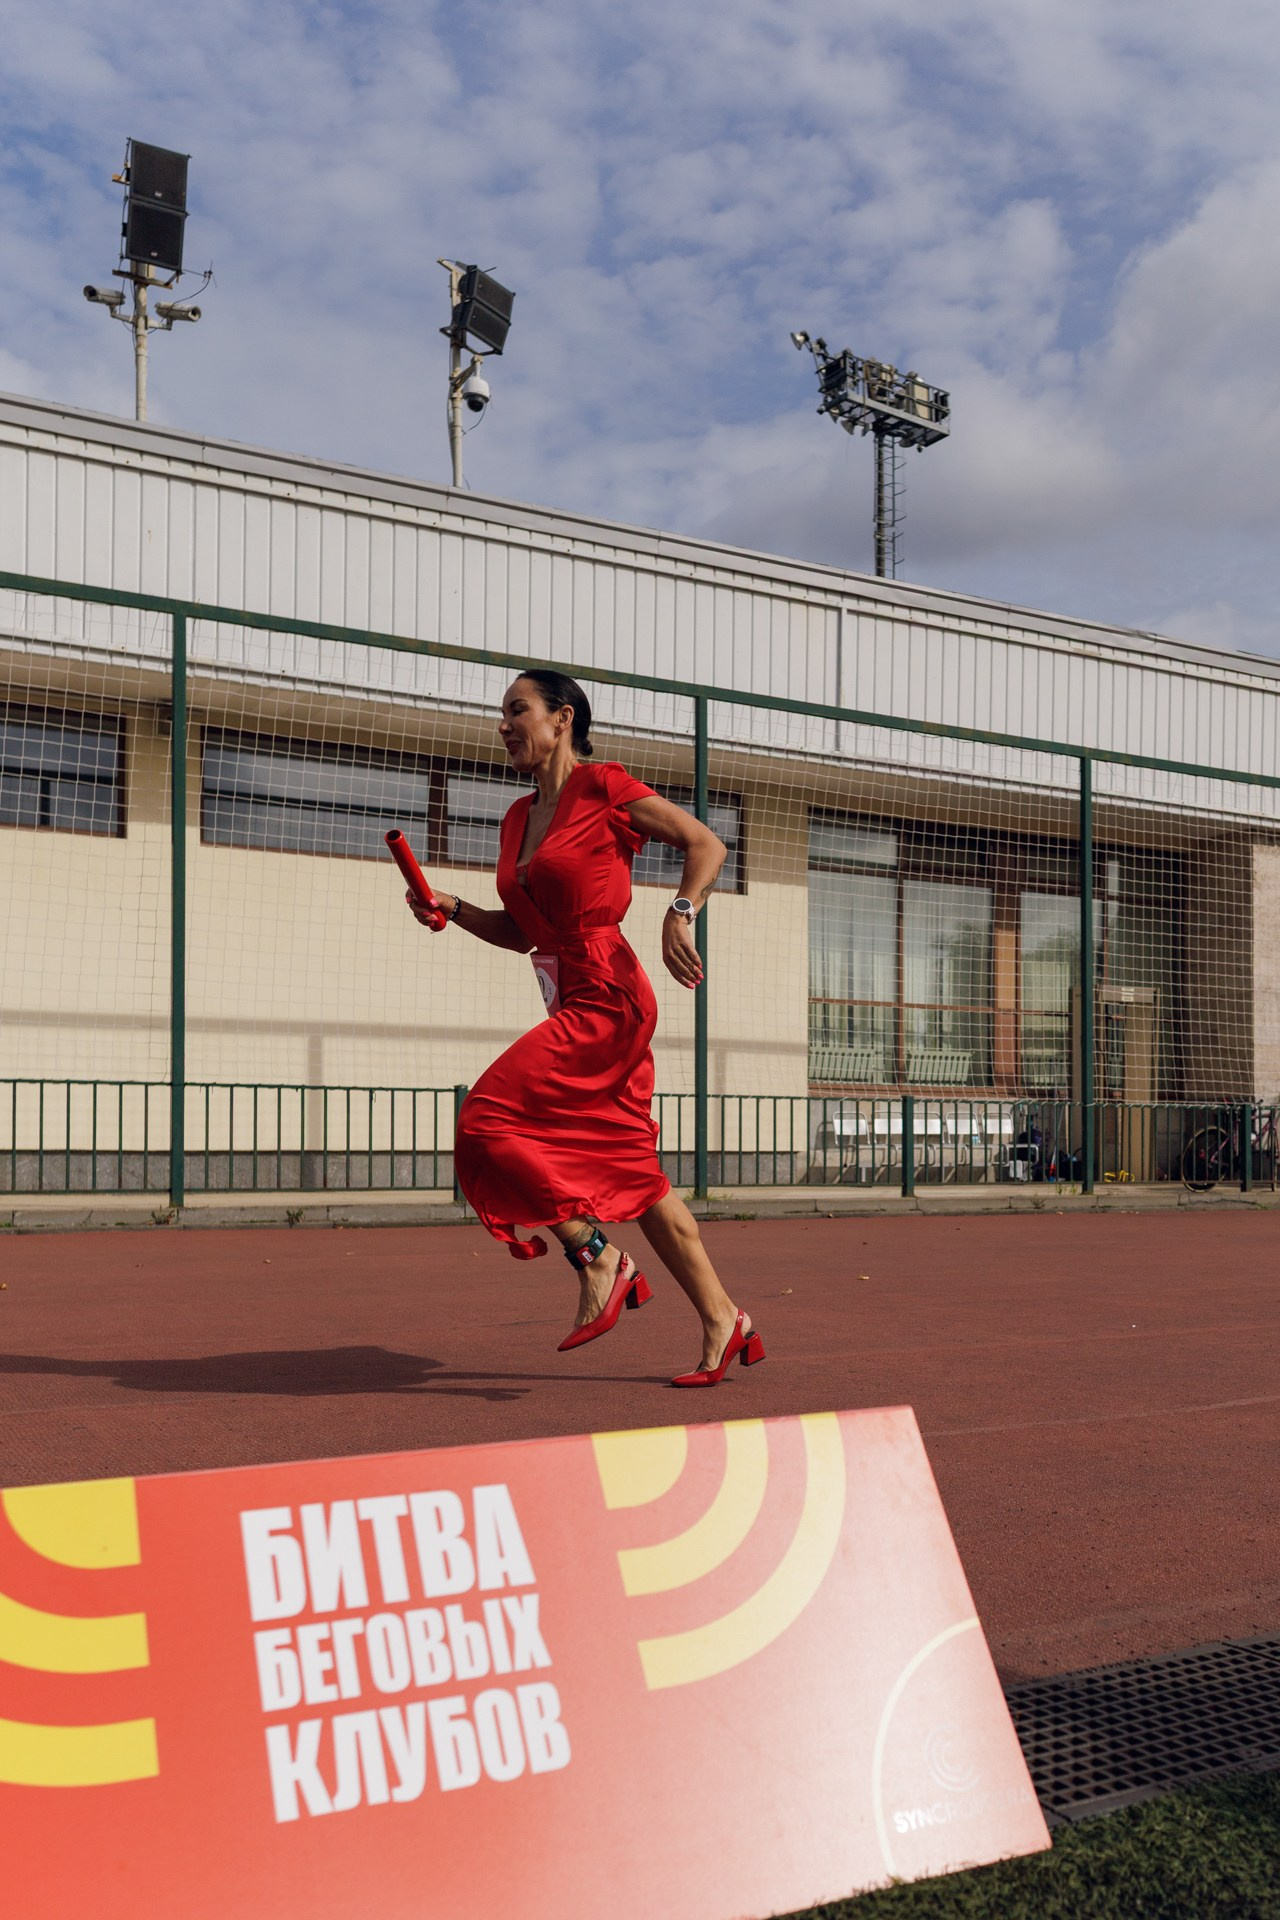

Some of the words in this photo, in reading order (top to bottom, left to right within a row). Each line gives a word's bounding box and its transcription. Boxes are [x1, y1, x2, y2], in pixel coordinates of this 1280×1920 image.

[239, 1483, 537, 1622] БИТВА
[253, 1592, 553, 1713] БЕГОВЫХ
[264, 1681, 572, 1824] КЛУБОВ
